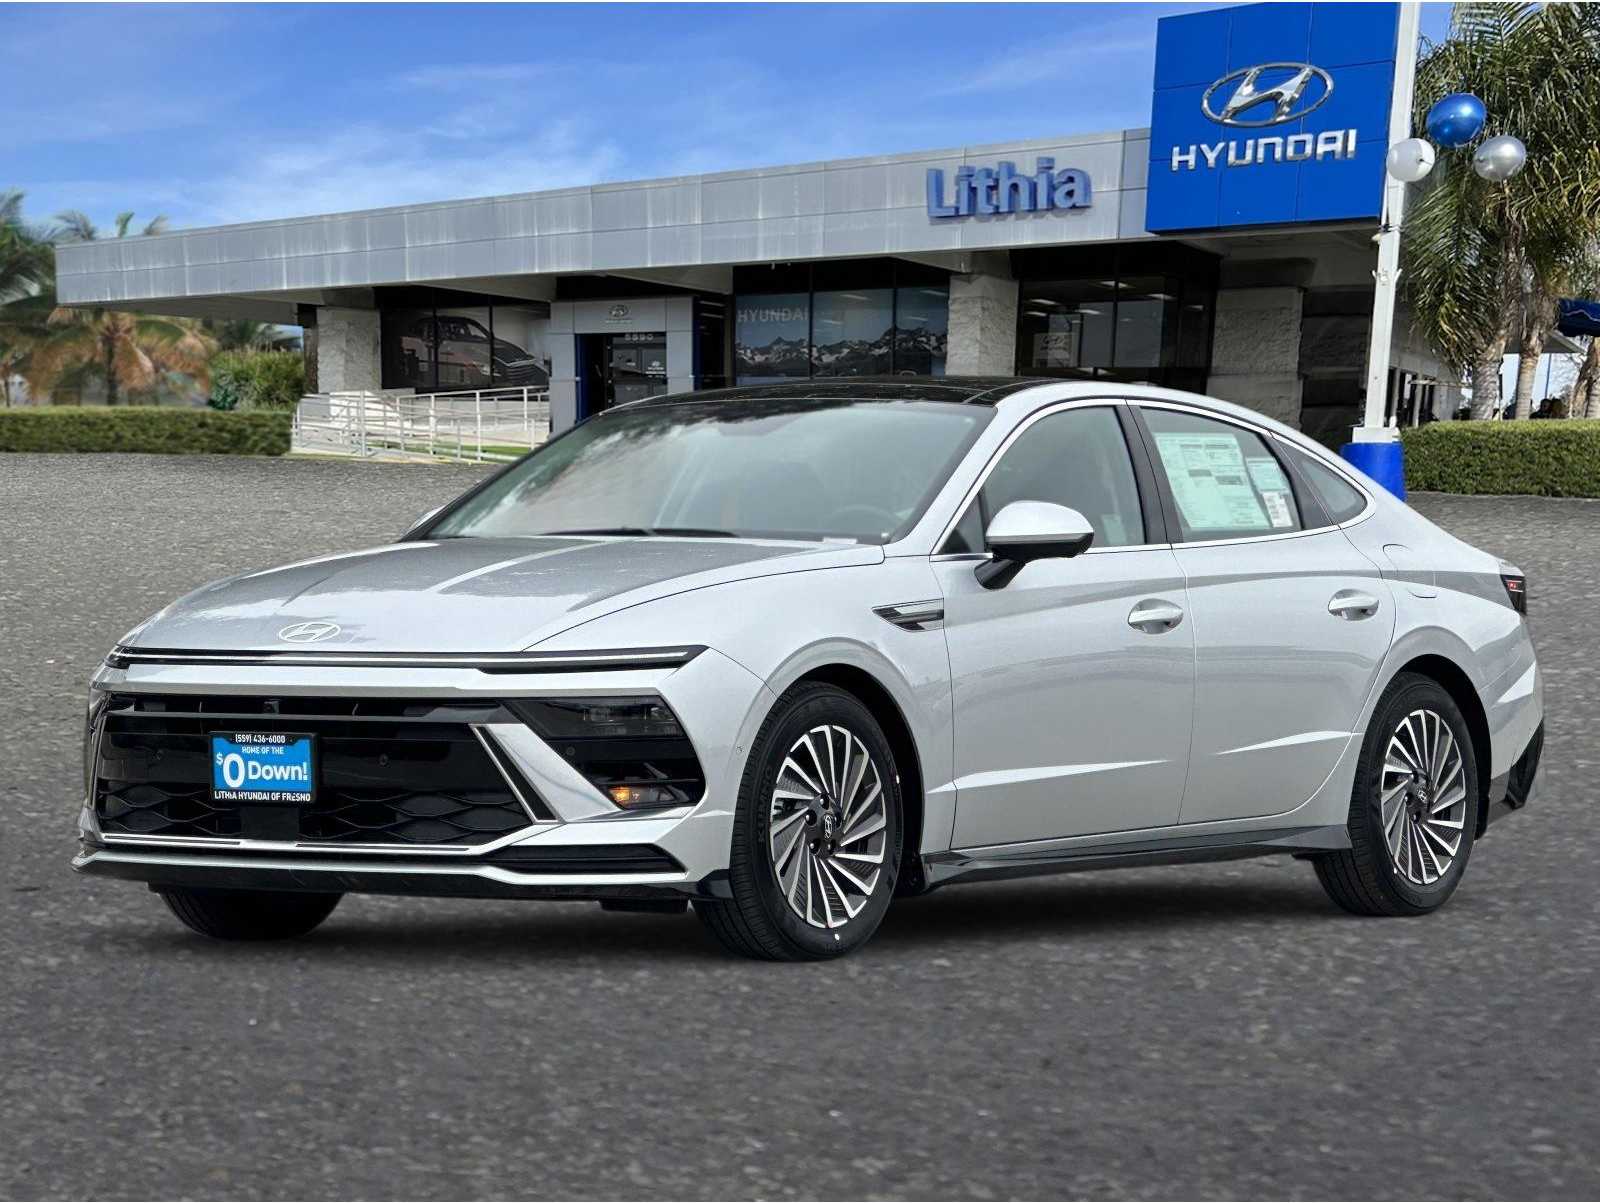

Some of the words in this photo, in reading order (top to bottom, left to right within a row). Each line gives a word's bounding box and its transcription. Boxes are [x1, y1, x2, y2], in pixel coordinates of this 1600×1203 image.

[1171, 128, 1358, 171] HYUNDAI
[927, 156, 1093, 218] Lithia
[737, 306, 809, 322] HYUNDAI
[235, 734, 251, 743] (559)
[253, 734, 286, 743] 436-6000
[242, 746, 260, 754] HOME
[261, 746, 270, 754] OF
[272, 746, 285, 755] THE
[248, 761, 308, 781] Down!
[214, 790, 237, 800] LITHIA
[238, 791, 270, 801] HYUNDAI
[271, 792, 281, 801] OF
[282, 792, 311, 802] FRESNO
